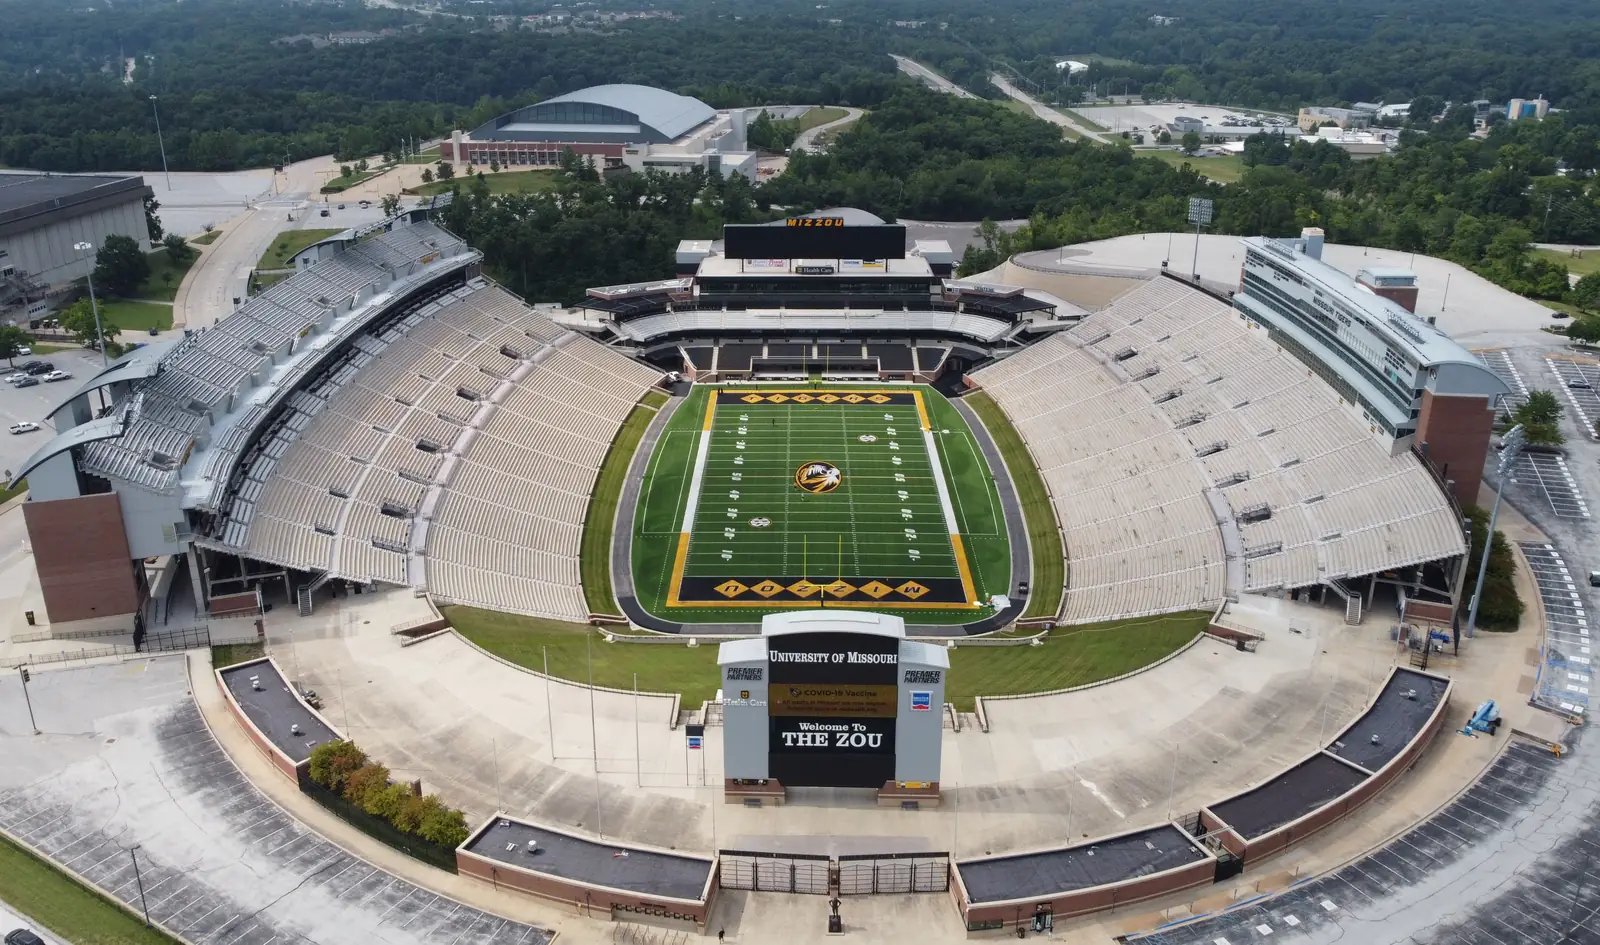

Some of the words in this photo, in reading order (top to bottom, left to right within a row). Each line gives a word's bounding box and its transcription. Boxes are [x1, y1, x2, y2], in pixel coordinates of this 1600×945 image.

[787, 218, 843, 227] MIZZOU
[1313, 296, 1335, 315] MISSOURI
[1335, 311, 1352, 328] TIGERS
[728, 667, 763, 675] PREMIER
[905, 670, 941, 678] PREMIER
[723, 698, 748, 706] Health
[750, 699, 767, 707] Care
[799, 723, 849, 731] Welcome
[852, 723, 867, 731] To
[782, 732, 829, 747] THE
[836, 733, 883, 748] ZOU
